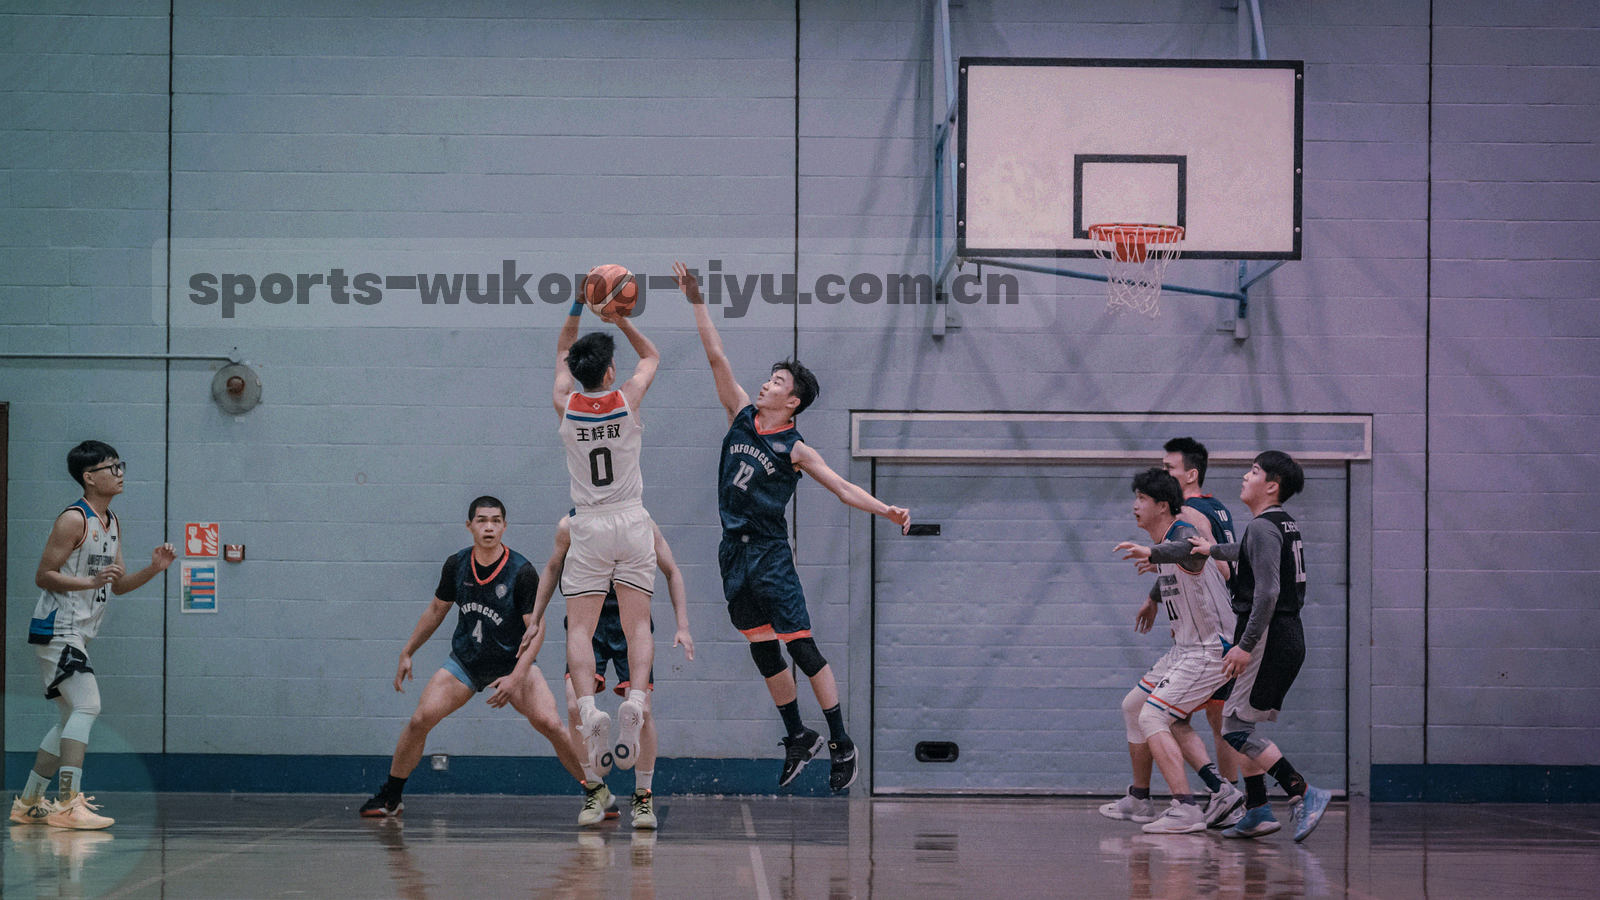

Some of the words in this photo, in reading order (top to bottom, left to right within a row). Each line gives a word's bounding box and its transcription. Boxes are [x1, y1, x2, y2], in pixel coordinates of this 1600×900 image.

[589, 447, 614, 487] 0
[730, 443, 776, 476] OXFORDCSSA
[732, 460, 755, 491] 12
[1165, 600, 1178, 621] 11
[472, 619, 483, 644] 4
